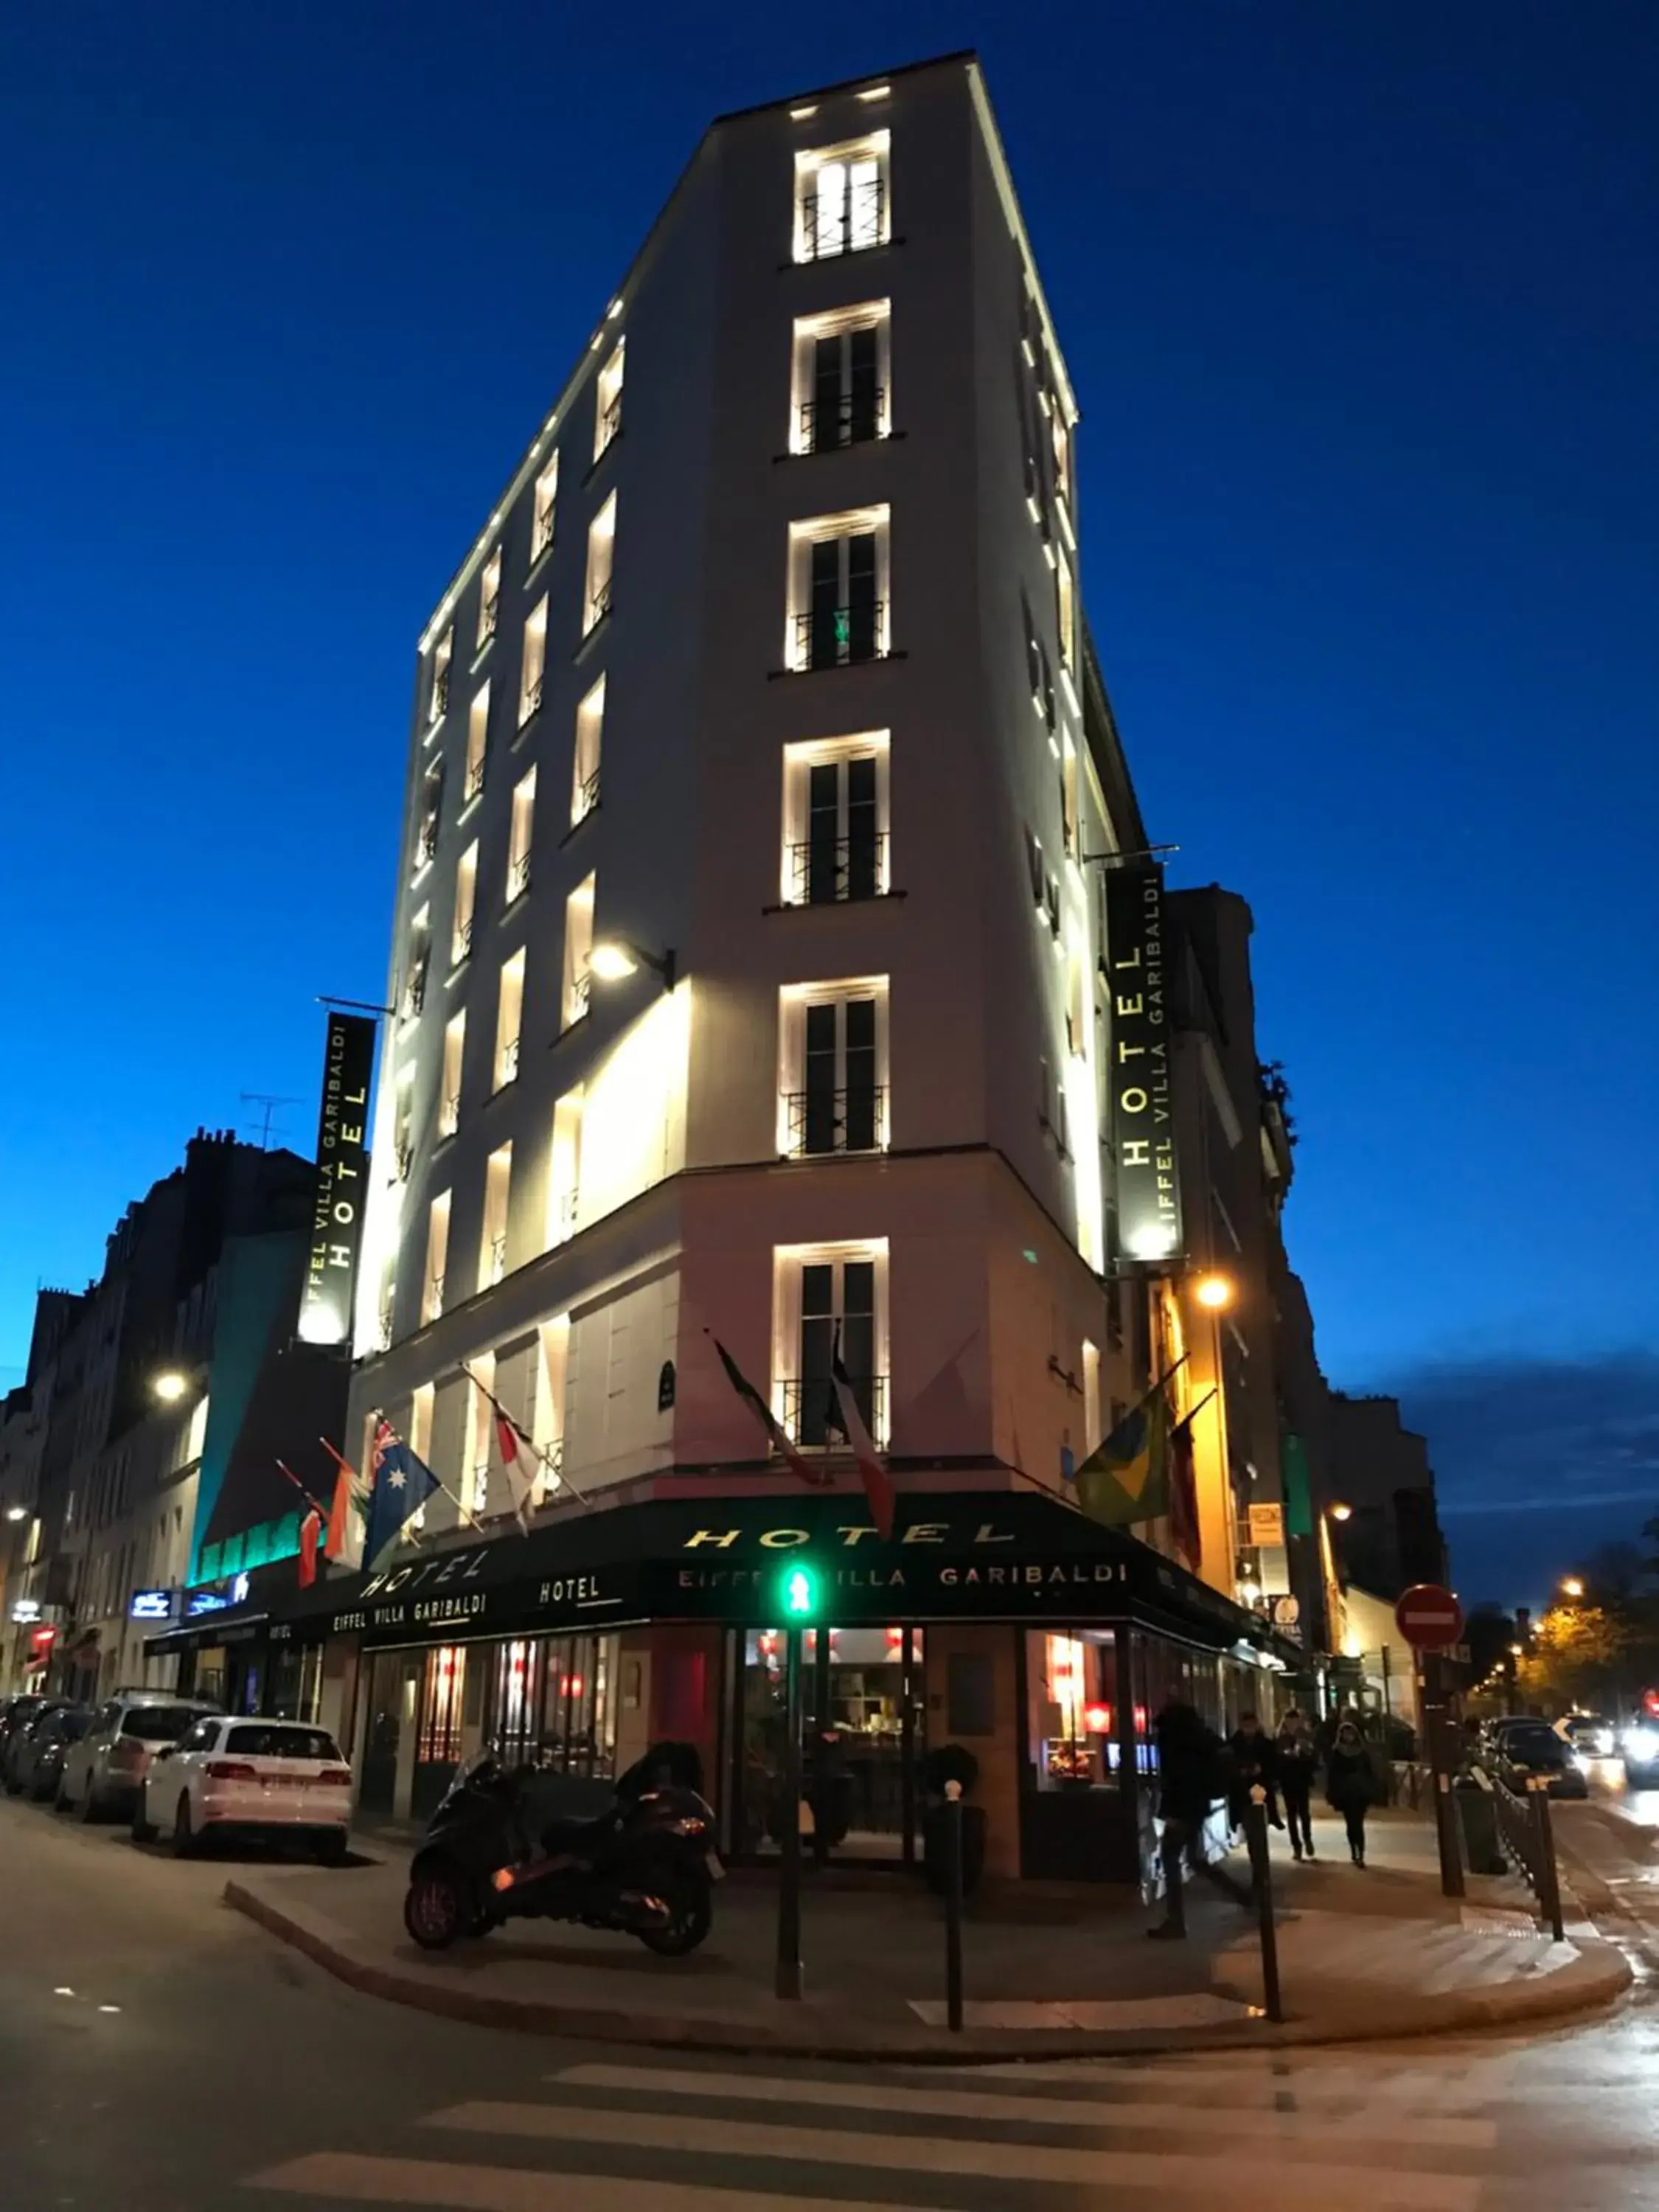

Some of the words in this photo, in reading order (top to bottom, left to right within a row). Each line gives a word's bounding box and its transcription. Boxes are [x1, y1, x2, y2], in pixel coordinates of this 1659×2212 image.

[1144, 878, 1164, 1025] GARIBALDI
[322, 1026, 346, 1149] GARIBALDI
[1115, 947, 1150, 1167] HOTEL
[1150, 1043, 1169, 1124] VILLA
[315, 1163, 333, 1230] VILLA
[329, 1086, 366, 1269] HOTEL
[307, 1241, 327, 1302] FFEL
[683, 1523, 1015, 1548] HOTEL
[359, 1549, 489, 1599] HOTEL
[539, 1576, 599, 1603] HOTEL
[678, 1569, 765, 1588] EIFF
[836, 1568, 907, 1587] ILLA
[939, 1563, 1127, 1585] GARIBALDI
[333, 1611, 366, 1632] EIFFEL
[374, 1604, 405, 1626] VILLA
[414, 1592, 487, 1621] GARIBALDI
